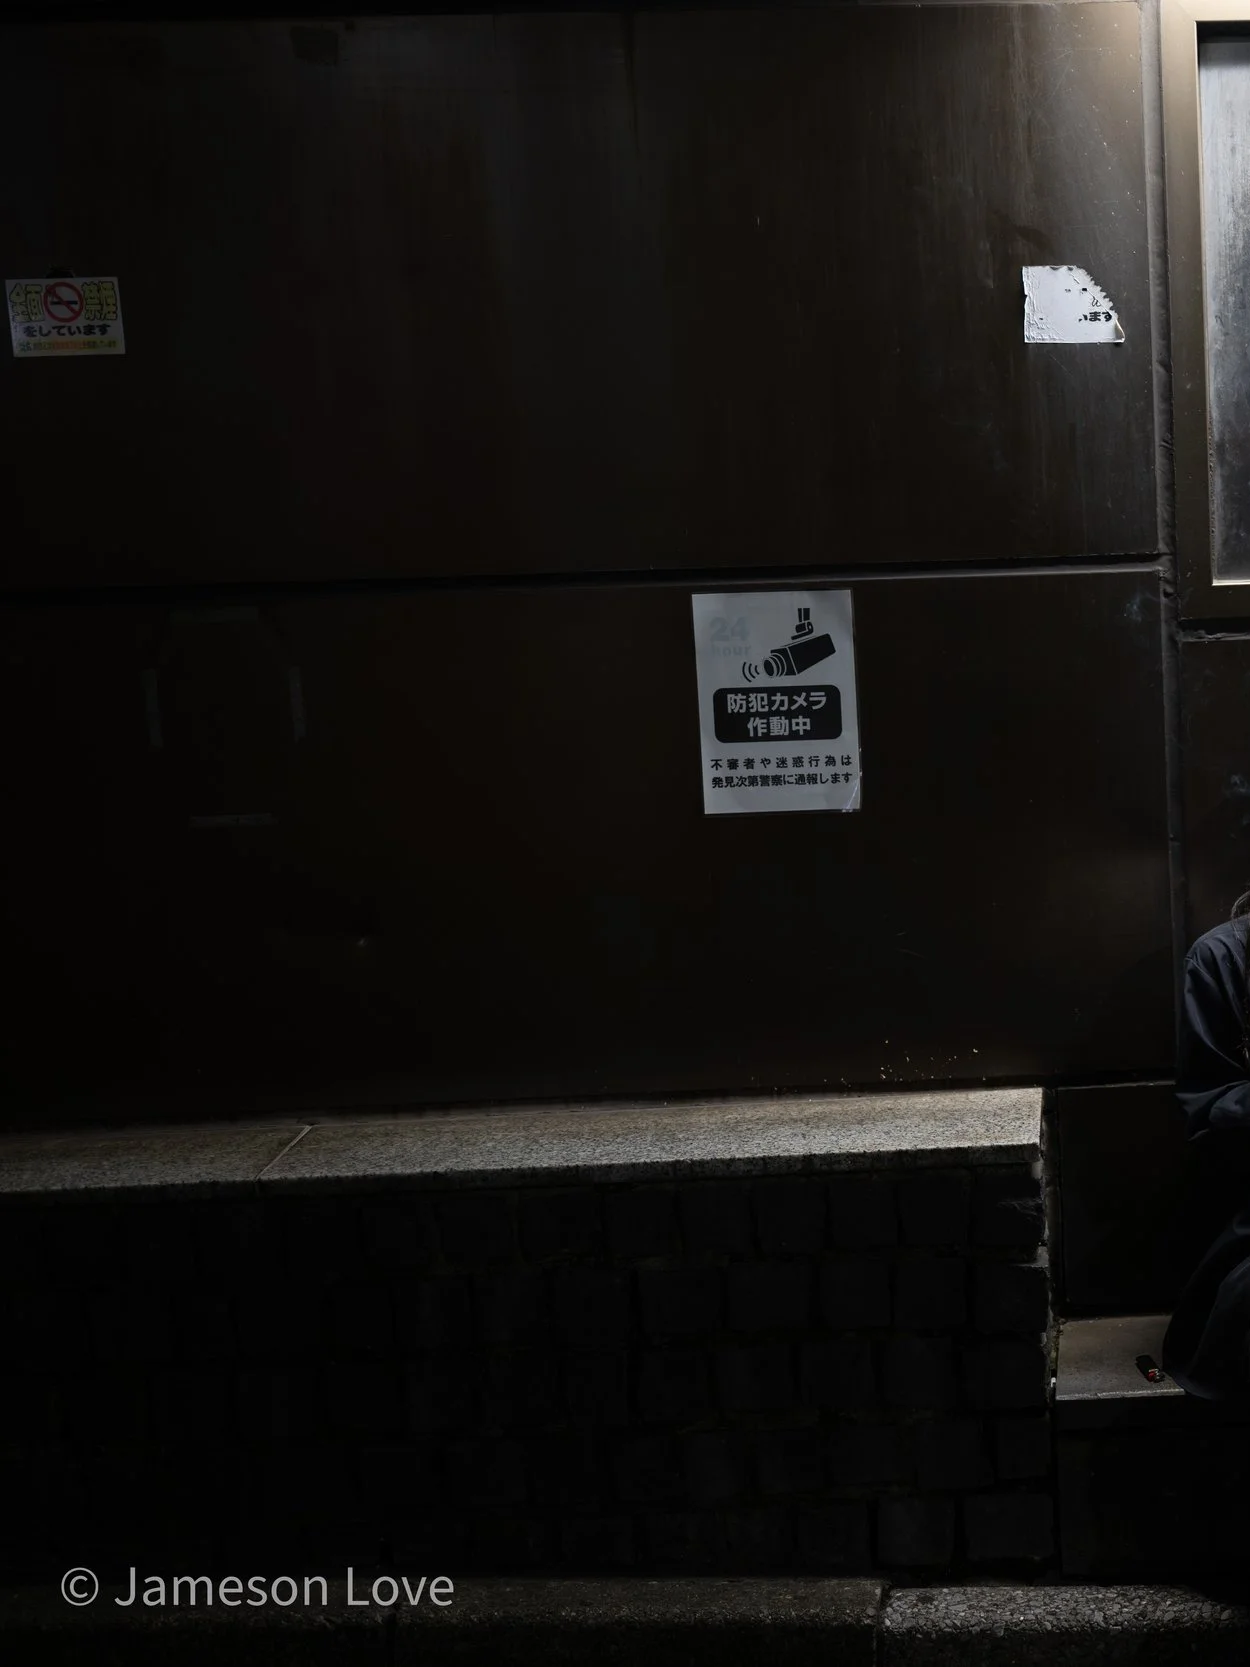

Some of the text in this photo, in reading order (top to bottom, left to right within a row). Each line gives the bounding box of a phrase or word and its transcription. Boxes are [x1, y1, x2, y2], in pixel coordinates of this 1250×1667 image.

[24, 324, 111, 338] をしています
[727, 691, 828, 714] 防犯カメラ
[747, 716, 812, 738] 作動中
[710, 754, 852, 771] 不審者や迷惑行為は
[711, 772, 853, 790] 発見次第警察に通報します
